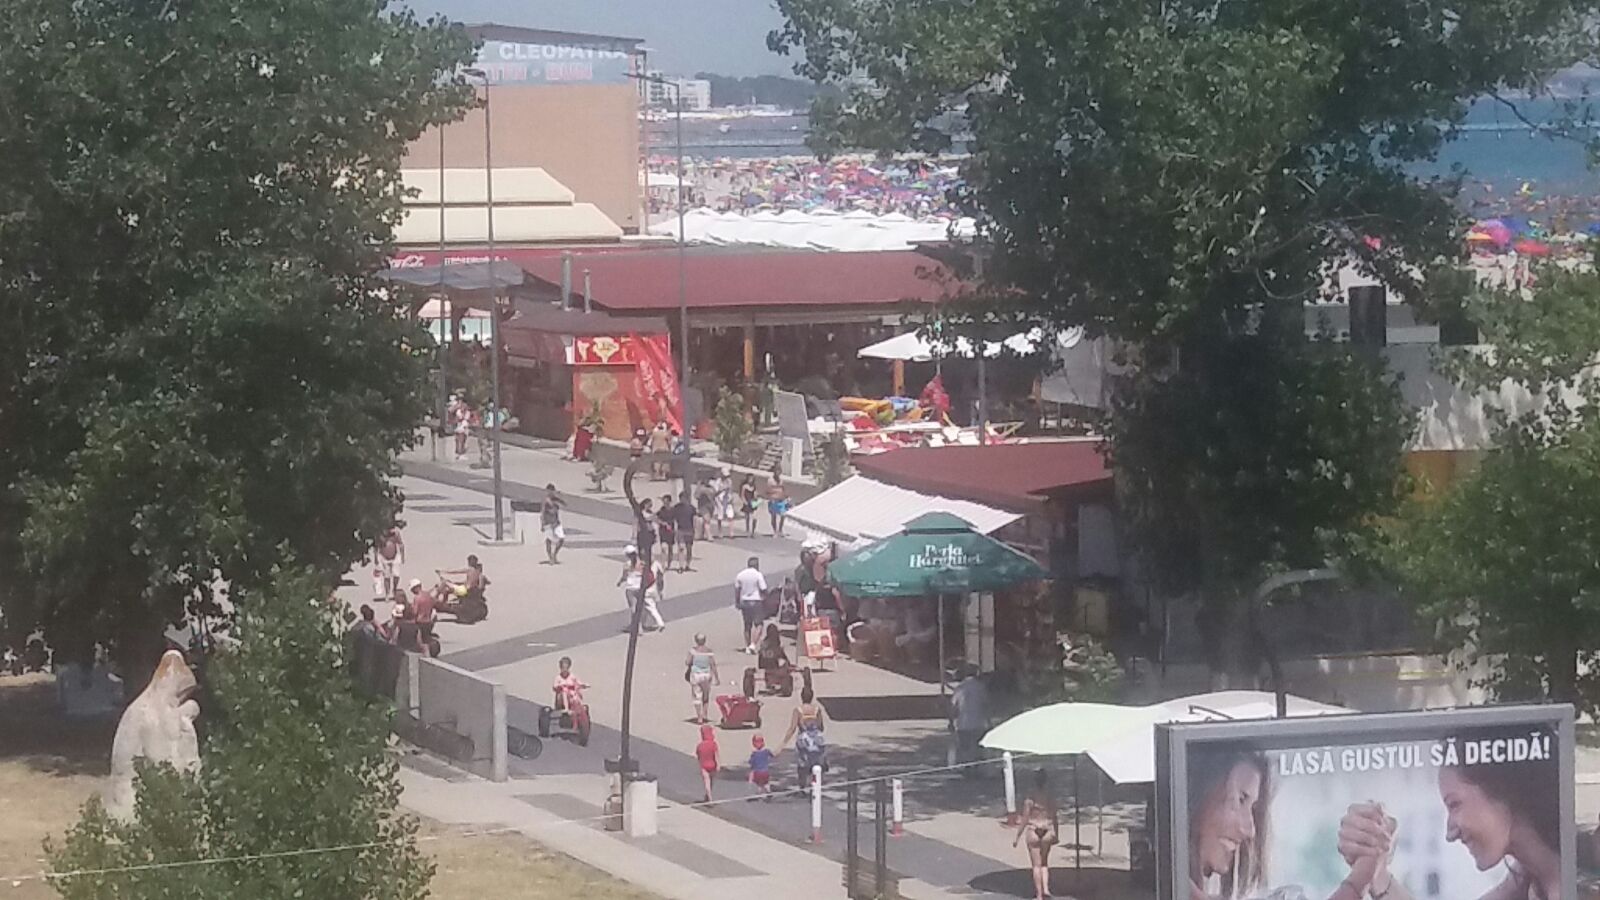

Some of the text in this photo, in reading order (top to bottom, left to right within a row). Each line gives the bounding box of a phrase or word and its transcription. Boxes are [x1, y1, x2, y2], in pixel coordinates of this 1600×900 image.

[498, 43, 628, 60] CLEOPATRA
[1341, 744, 1424, 772] GUSTUL
[1430, 737, 1459, 766] SĂ
[1465, 731, 1550, 765] DECIDĂ!
